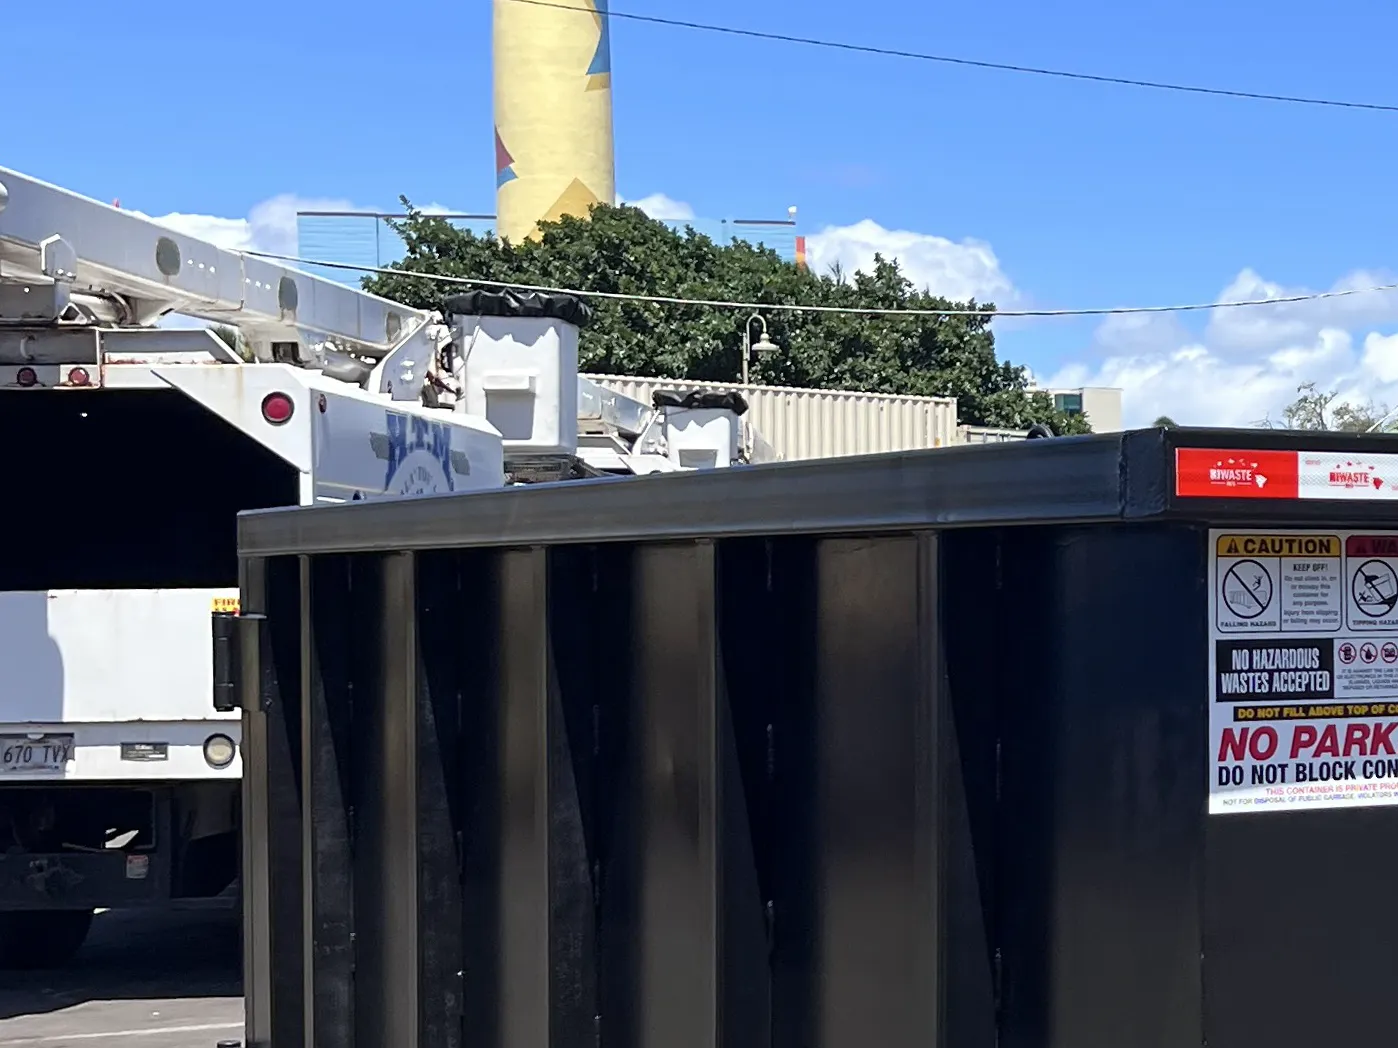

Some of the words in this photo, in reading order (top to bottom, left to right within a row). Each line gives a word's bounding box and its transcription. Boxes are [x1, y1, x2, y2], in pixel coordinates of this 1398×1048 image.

[1243, 538, 1331, 554] CAUTION
[1232, 648, 1250, 670] NO
[1252, 647, 1320, 670] HAZARDOUS
[1221, 671, 1270, 694] WASTES
[1272, 670, 1330, 693] ACCEPTED
[1237, 708, 1255, 719] DO
[1257, 707, 1281, 718] NOT
[1283, 707, 1307, 718] FILL
[1308, 705, 1345, 717] ABOVE
[1346, 704, 1369, 715] TOP
[1371, 704, 1386, 715] OF
[1217, 725, 1279, 762] NO
[3, 744, 33, 763] 670
[1218, 765, 1245, 787] DO
[1251, 763, 1289, 785] NOT
[1295, 760, 1357, 783] BLOCK
[1266, 787, 1285, 796] THIS
[1286, 785, 1334, 795] CONTAINER
[1335, 785, 1343, 793] IS
[1345, 783, 1378, 792] PRIVATE
[1223, 798, 1237, 806] NOT
[1254, 796, 1286, 805] DISPOSAL
